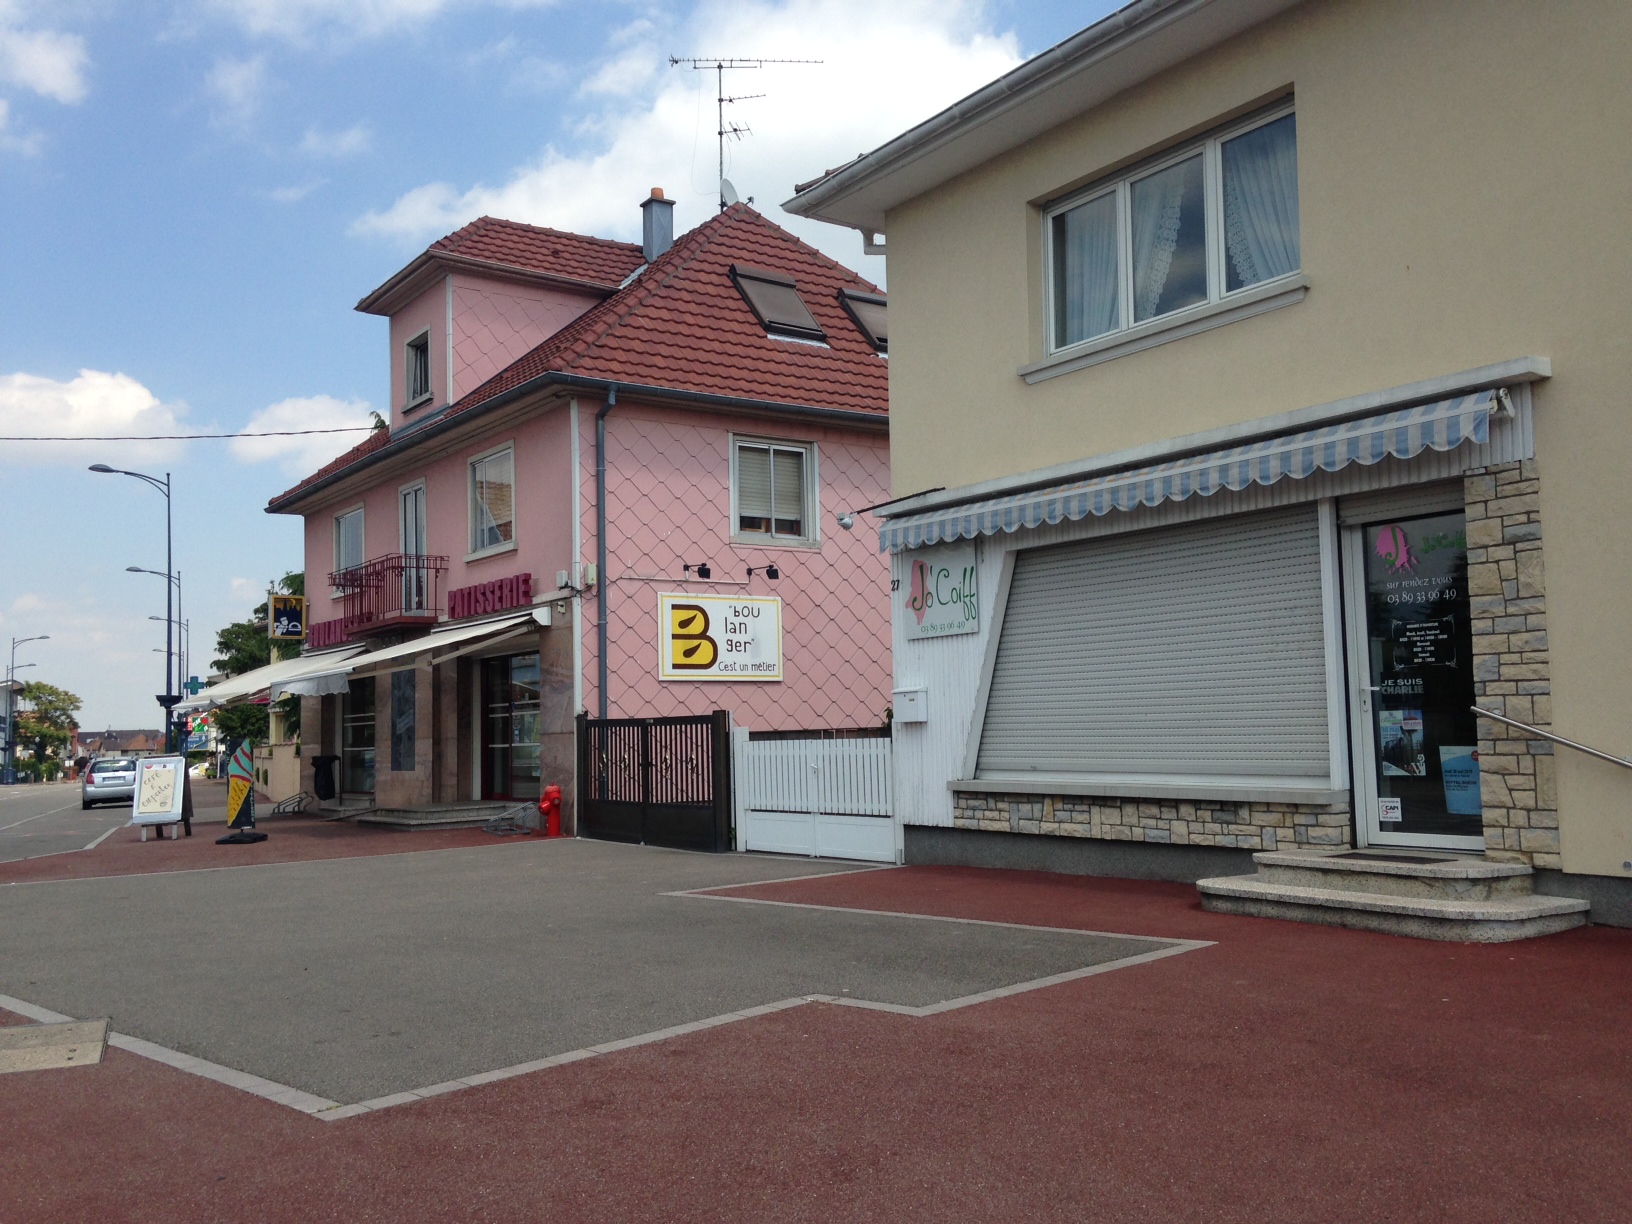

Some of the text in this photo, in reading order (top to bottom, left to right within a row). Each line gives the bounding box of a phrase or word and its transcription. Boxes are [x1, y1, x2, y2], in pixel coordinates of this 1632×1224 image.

[890, 579, 900, 591] 27
[448, 573, 532, 619] PATISSERIE
[1387, 587, 1457, 605] 03 89 33 96 49
[920, 620, 966, 635] 03 89 33 96 49
[1397, 678, 1423, 686] SUIS
[1381, 686, 1424, 695] CHARLIE
